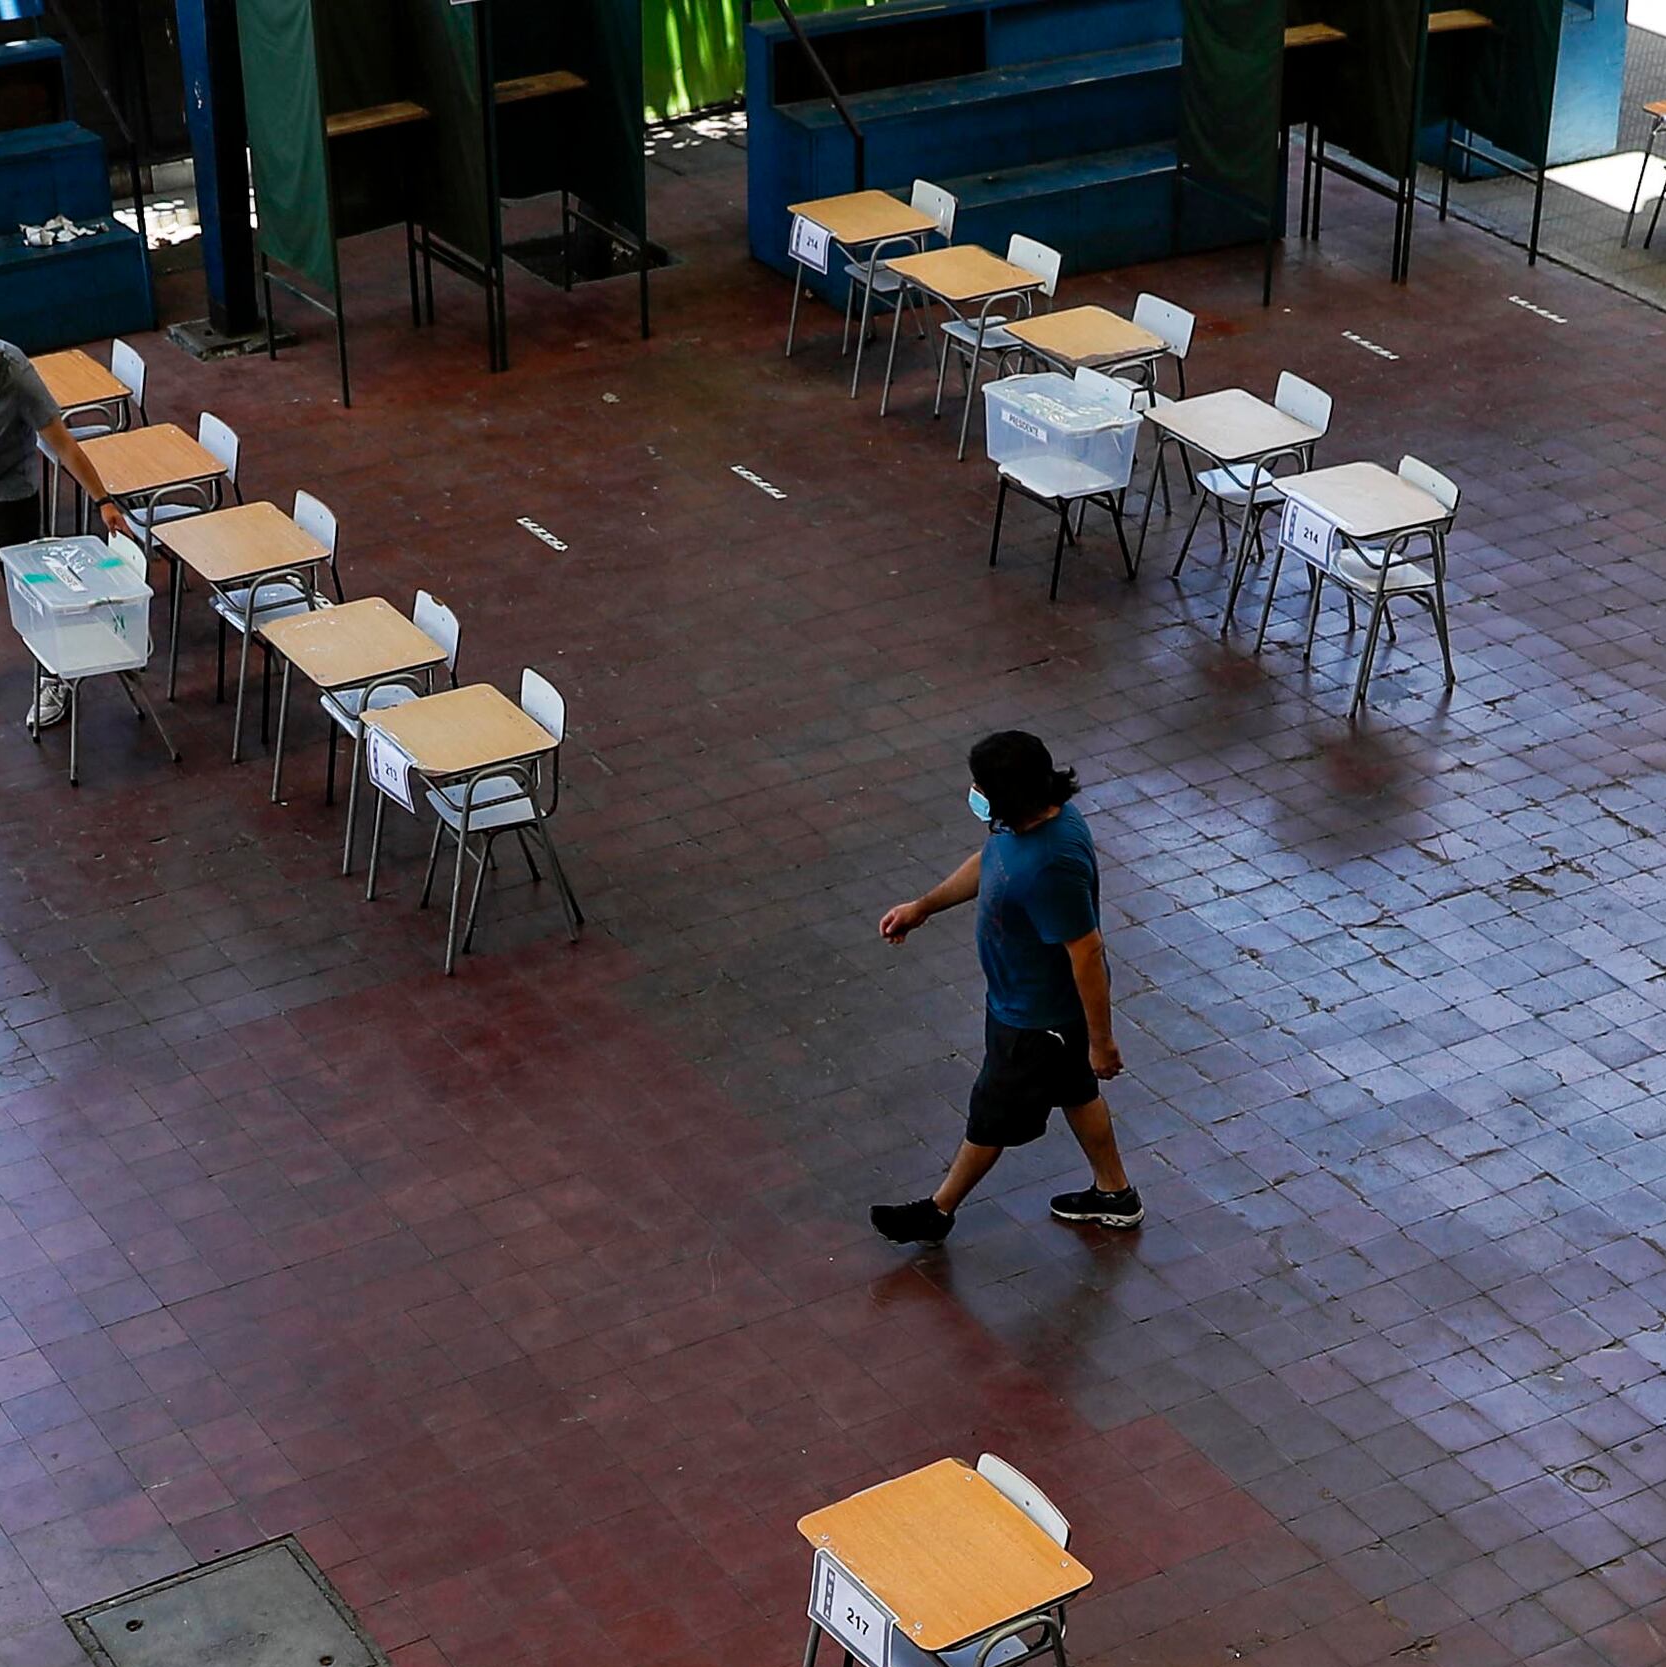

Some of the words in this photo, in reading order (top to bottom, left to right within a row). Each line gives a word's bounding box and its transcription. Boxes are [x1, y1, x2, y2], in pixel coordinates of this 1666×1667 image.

[1009, 414, 1039, 437] PRESIDENTE
[1303, 526, 1318, 545] 214
[846, 1607, 869, 1636] 217
